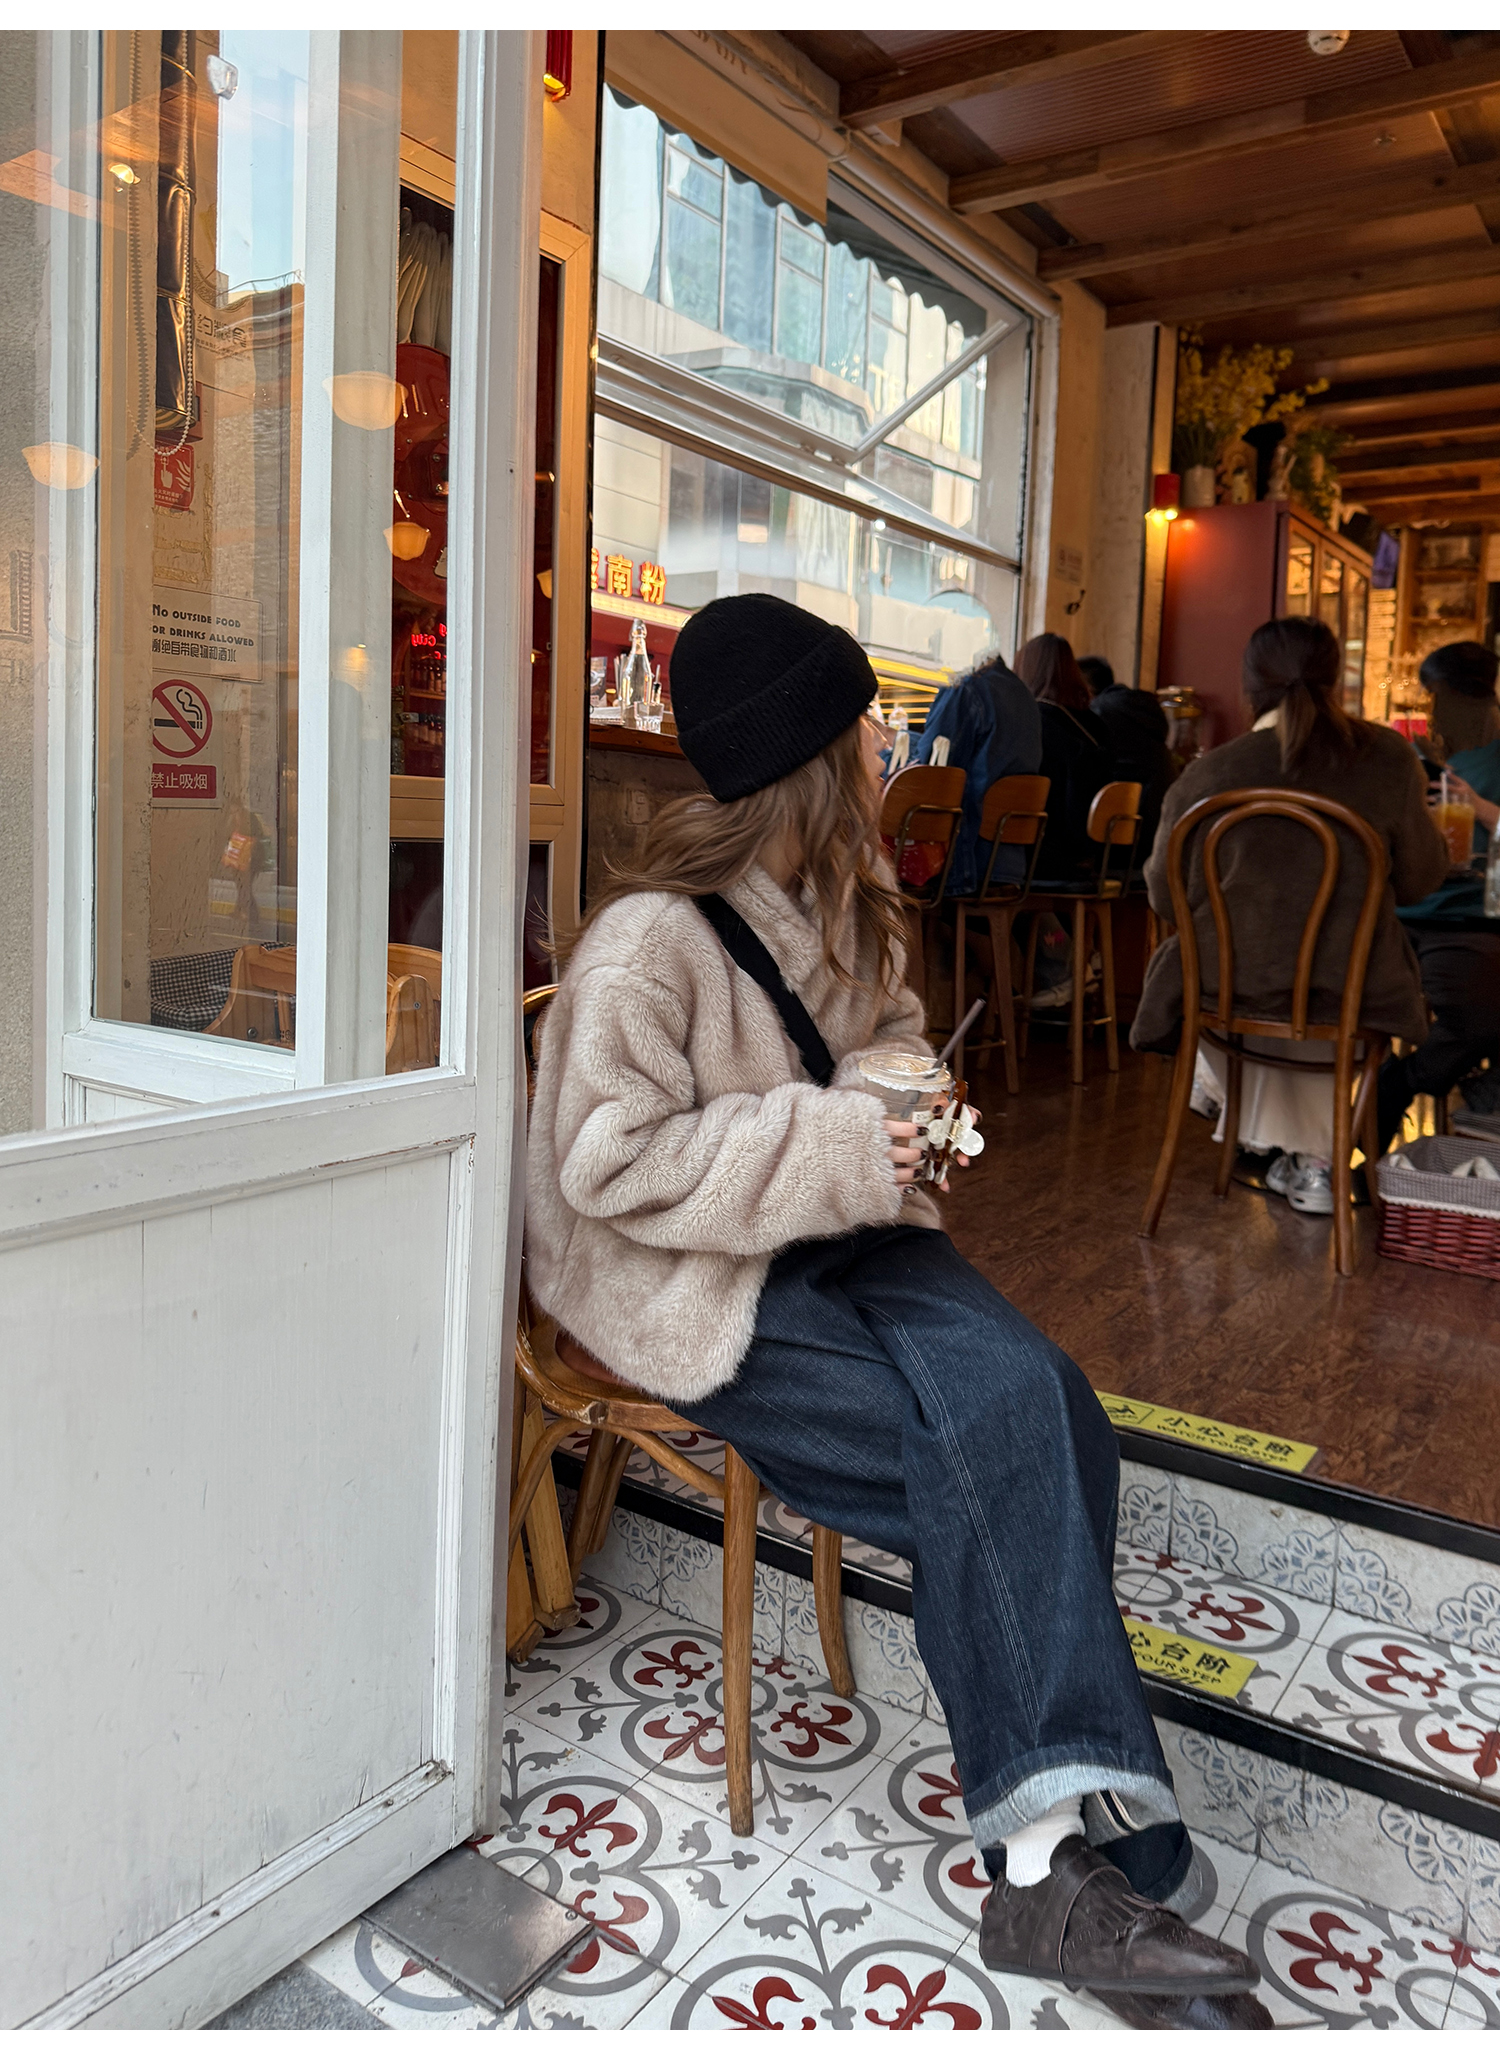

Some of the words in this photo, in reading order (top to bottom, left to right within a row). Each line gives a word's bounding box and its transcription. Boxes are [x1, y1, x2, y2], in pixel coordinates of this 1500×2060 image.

[152, 604, 168, 617] No
[172, 610, 212, 624] OUTSIDE
[216, 617, 241, 628] FOOD
[152, 625, 165, 634] OR
[169, 627, 206, 640] DRINKS
[209, 633, 254, 646] ALLOWED
[151, 638, 237, 662] 谢绝自带食物和酒水
[151, 772, 208, 789] 禁止吸烟
[1156, 1423, 1206, 1441] WATCH
[1207, 1437, 1252, 1454] YOUR
[1251, 1449, 1289, 1463] STEP
[1163, 1415, 1295, 1457] 小心台阶
[1179, 1666, 1222, 1683] STEP
